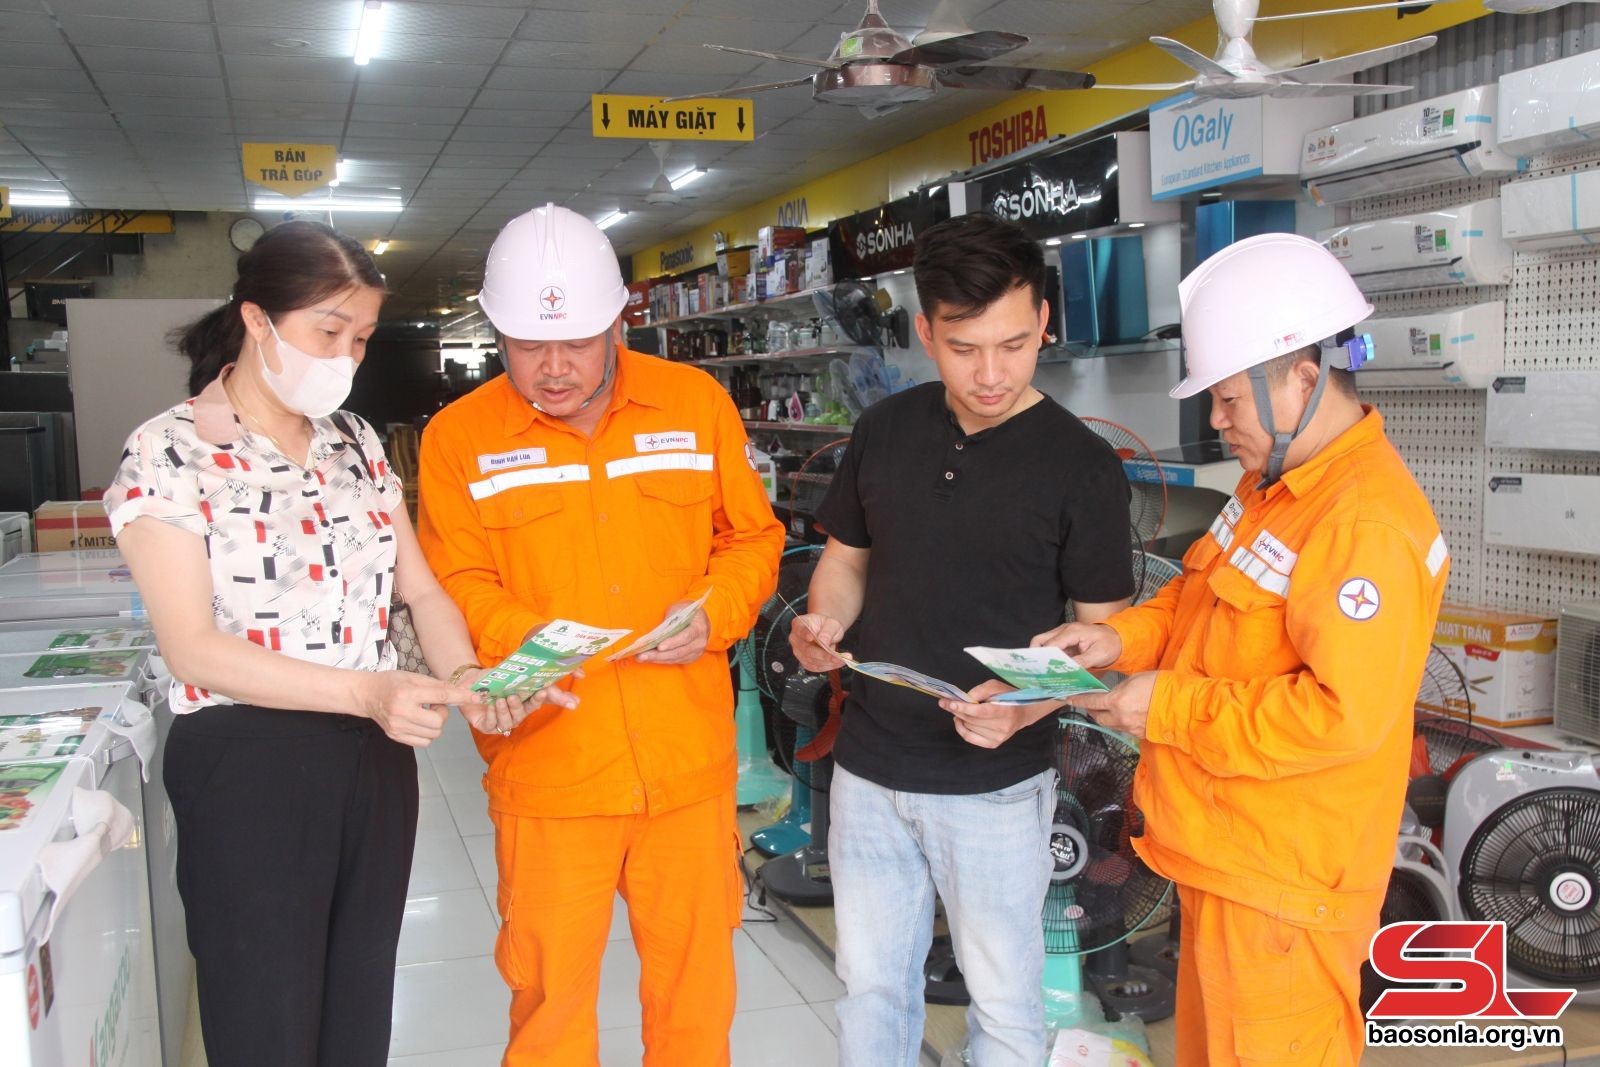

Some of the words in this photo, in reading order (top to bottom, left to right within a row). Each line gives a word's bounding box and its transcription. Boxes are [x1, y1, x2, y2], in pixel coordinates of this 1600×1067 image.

[628, 104, 669, 129] MÁY
[676, 106, 717, 134] GIẶT
[1173, 107, 1234, 152] OGaly
[969, 105, 1048, 167] TOSHIBA
[777, 197, 809, 227] AQUA
[867, 221, 915, 256] SONHA
[660, 241, 694, 272] Panasonic
[539, 312, 568, 321] EVNNPC
[660, 436, 689, 445] EVNNPC
